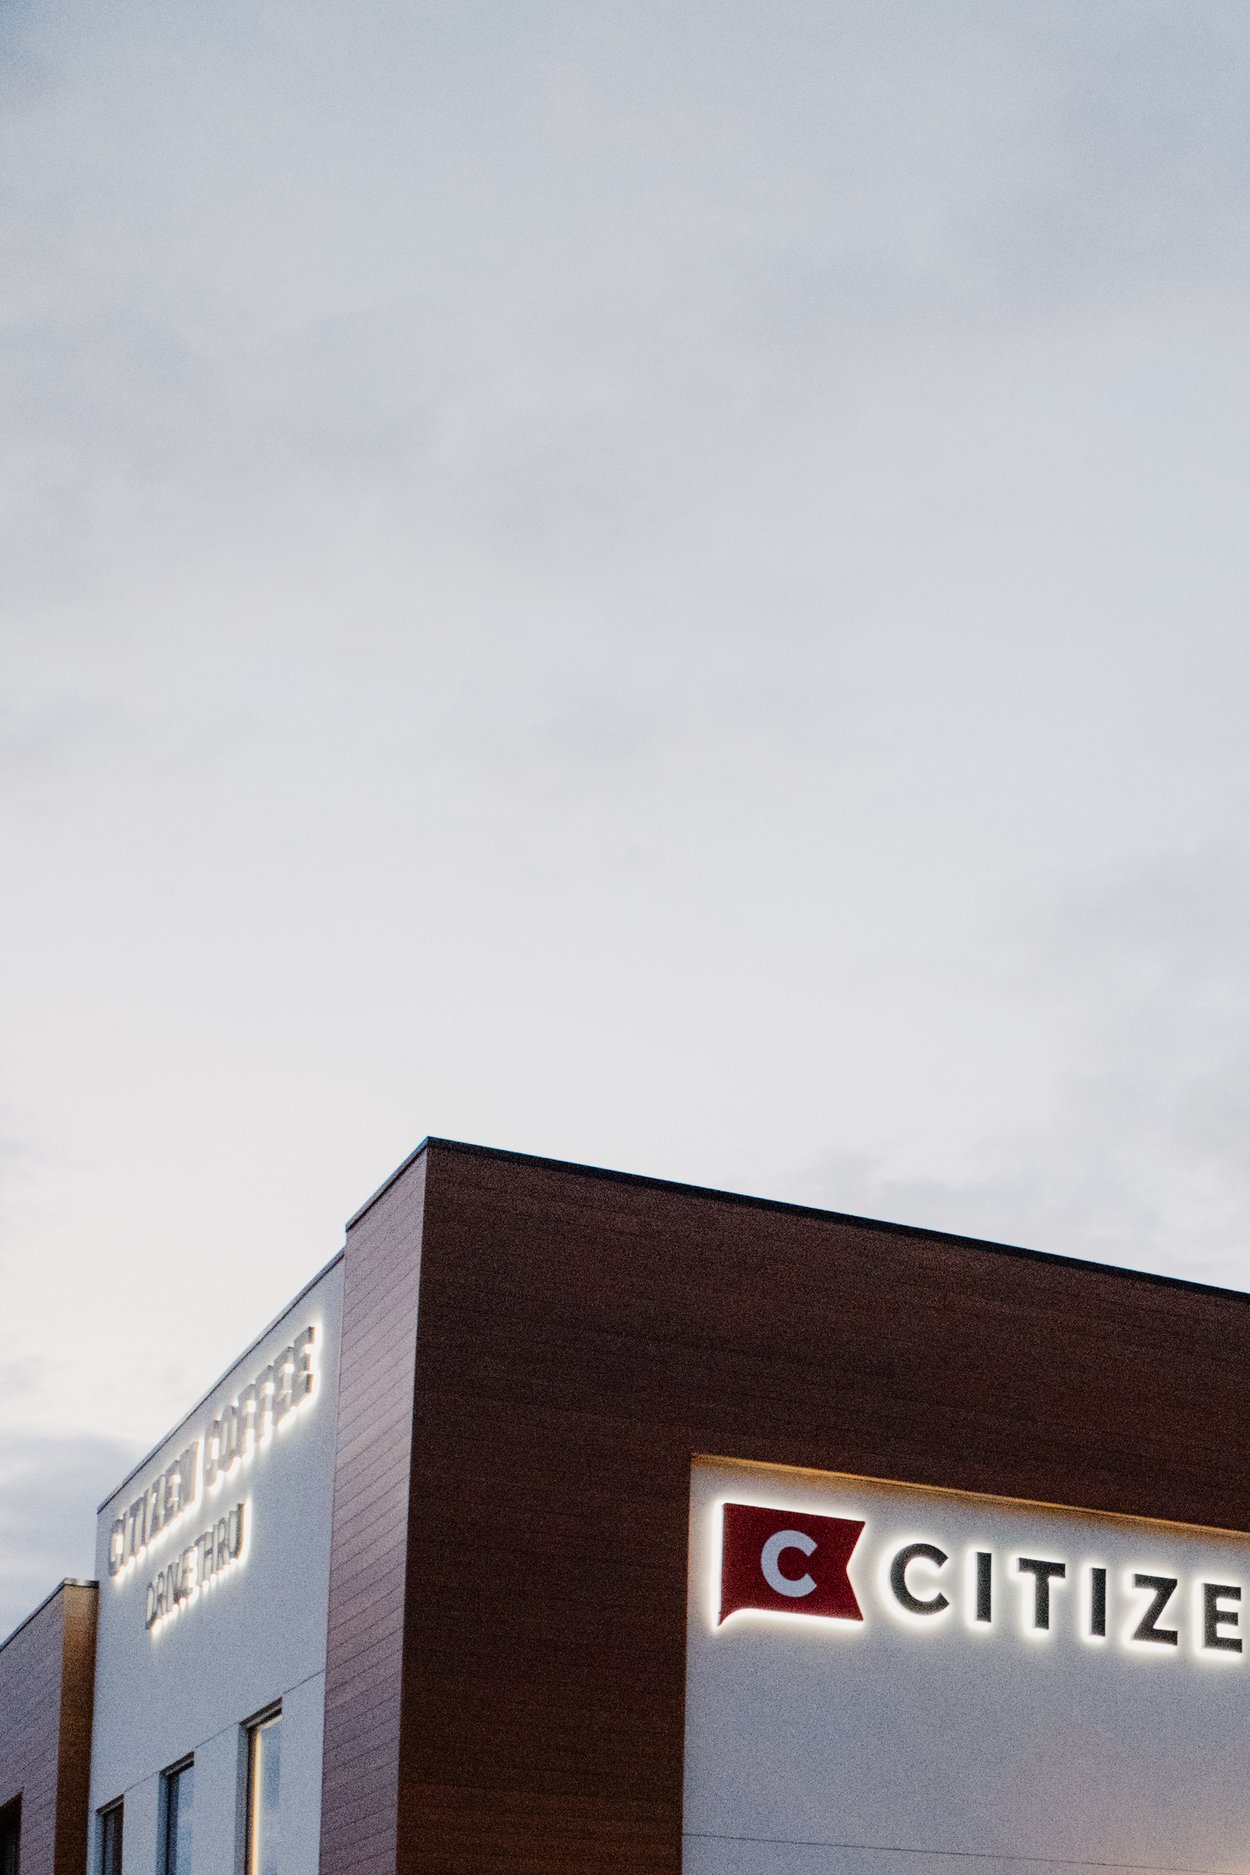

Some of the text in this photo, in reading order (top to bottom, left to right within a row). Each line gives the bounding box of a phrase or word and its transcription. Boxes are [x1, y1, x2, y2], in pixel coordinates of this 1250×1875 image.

[203, 1326, 316, 1489] COFFEE
[194, 1502, 246, 1592] THRU
[759, 1529, 819, 1598] C
